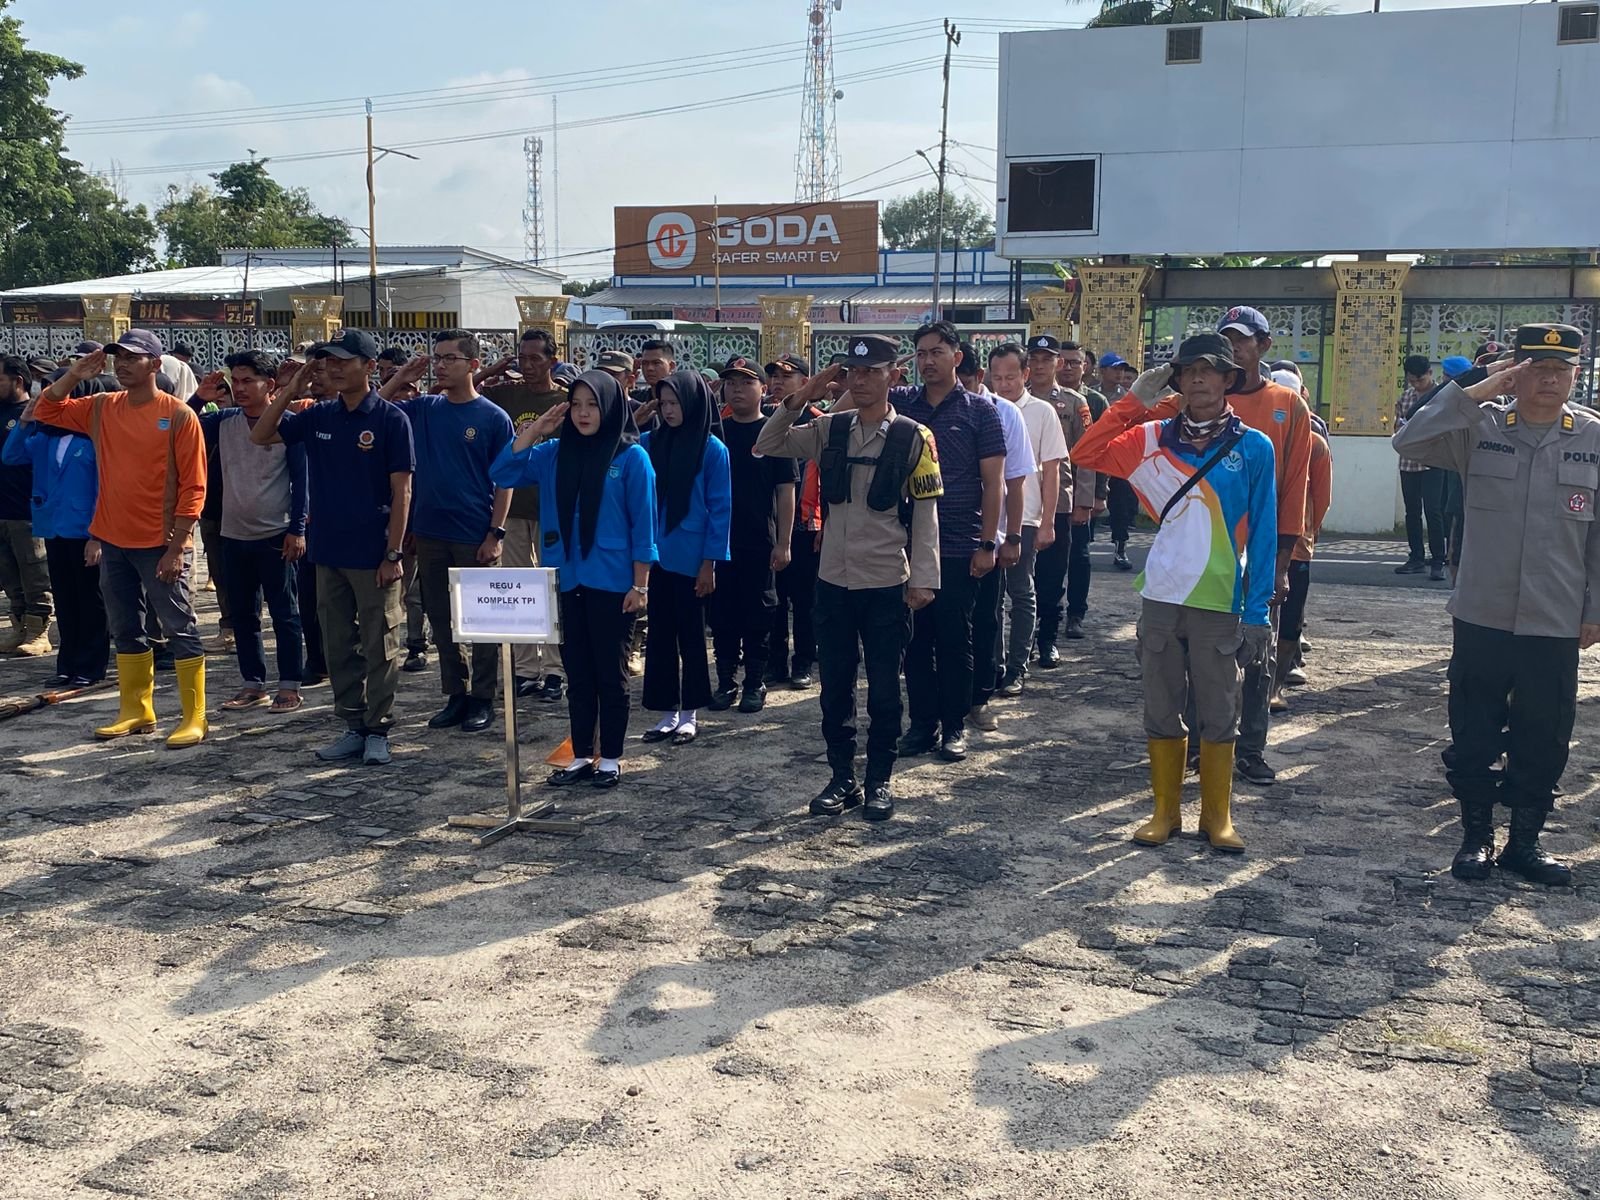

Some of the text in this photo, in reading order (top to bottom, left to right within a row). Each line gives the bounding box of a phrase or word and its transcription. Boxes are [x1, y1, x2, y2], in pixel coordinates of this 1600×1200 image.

[712, 214, 841, 246] GODA
[712, 251, 841, 264] SAFER SMART EV
[1476, 441, 1516, 456] JONSON
[1563, 451, 1600, 465] POLRI
[489, 582, 514, 590] REGU
[477, 596, 536, 605] KOMPLEK TPI
